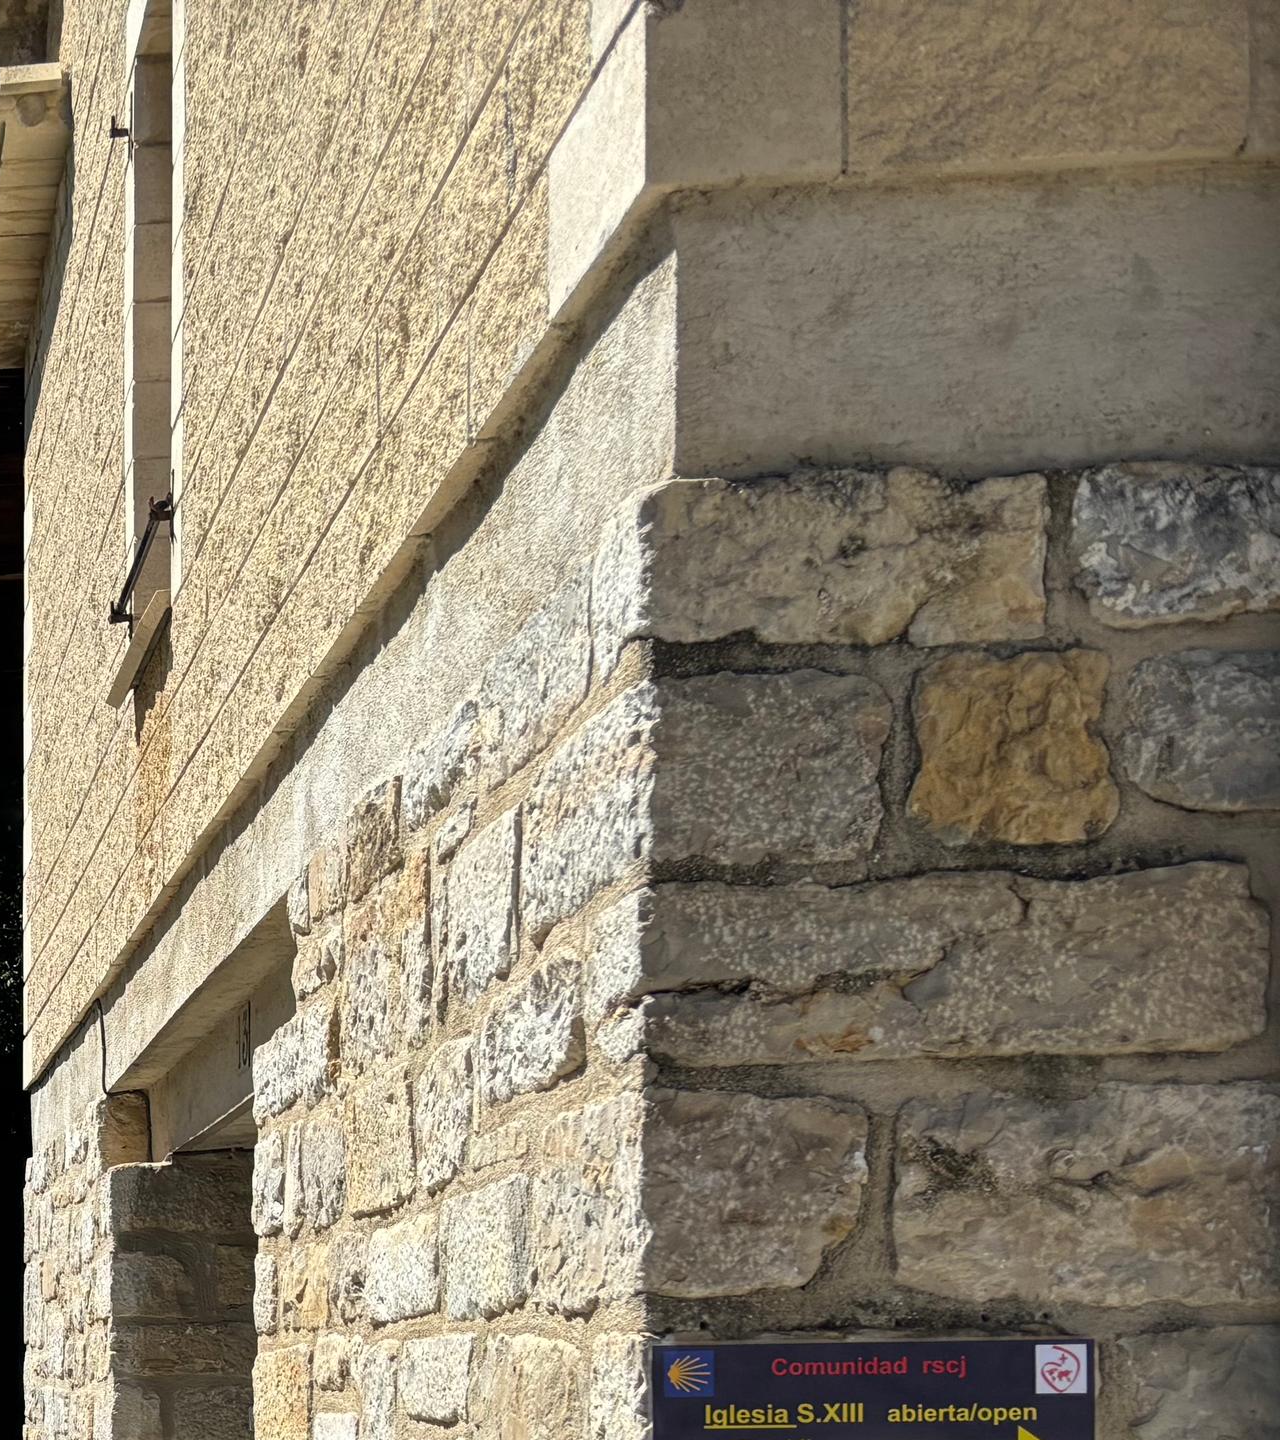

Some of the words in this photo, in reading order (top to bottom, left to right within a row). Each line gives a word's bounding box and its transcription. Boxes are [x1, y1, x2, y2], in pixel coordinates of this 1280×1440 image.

[771, 1356, 909, 1376] Comunidad
[922, 1355, 967, 1378] rscj
[705, 1404, 789, 1426] Iglesia
[797, 1403, 865, 1424] S.XIII
[887, 1402, 1038, 1426] abierta/open
